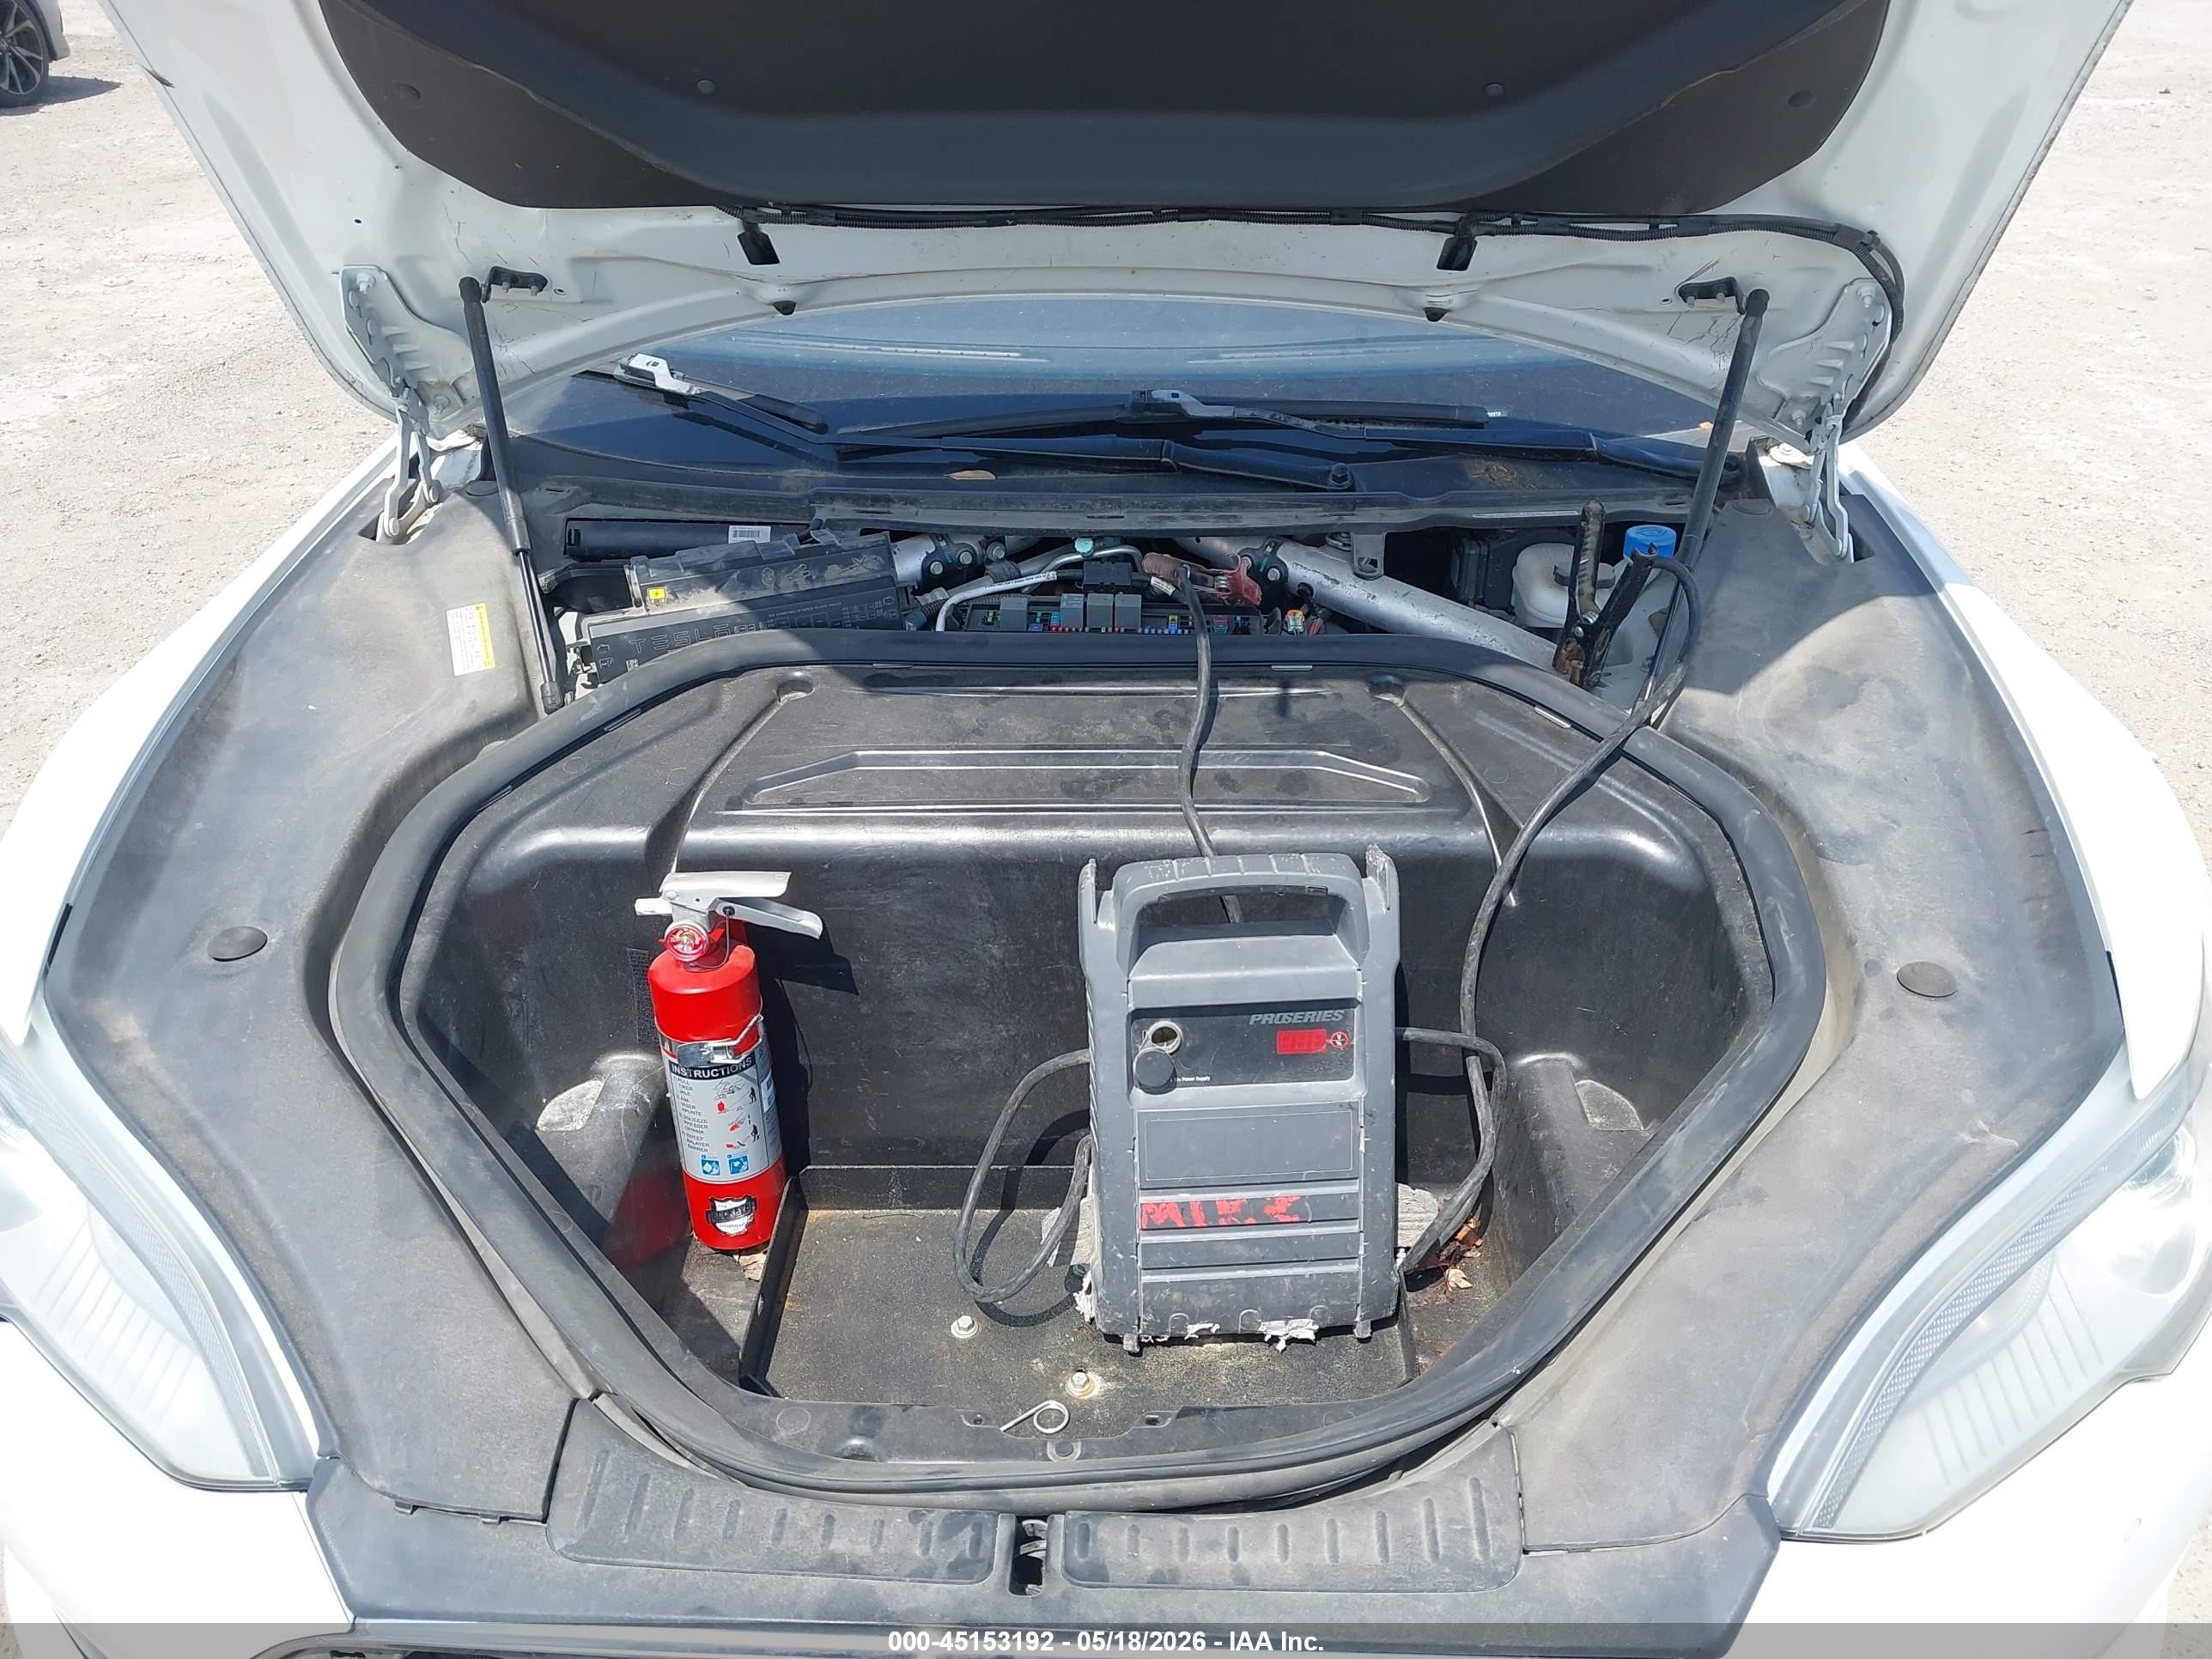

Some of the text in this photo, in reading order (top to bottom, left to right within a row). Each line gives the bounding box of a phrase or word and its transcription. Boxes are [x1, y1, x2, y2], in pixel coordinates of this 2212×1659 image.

[629, 624, 732, 653] TESLA
[1249, 1010, 1345, 1024] PROSERIES
[672, 1056, 753, 1079] INSTRUCTIONS
